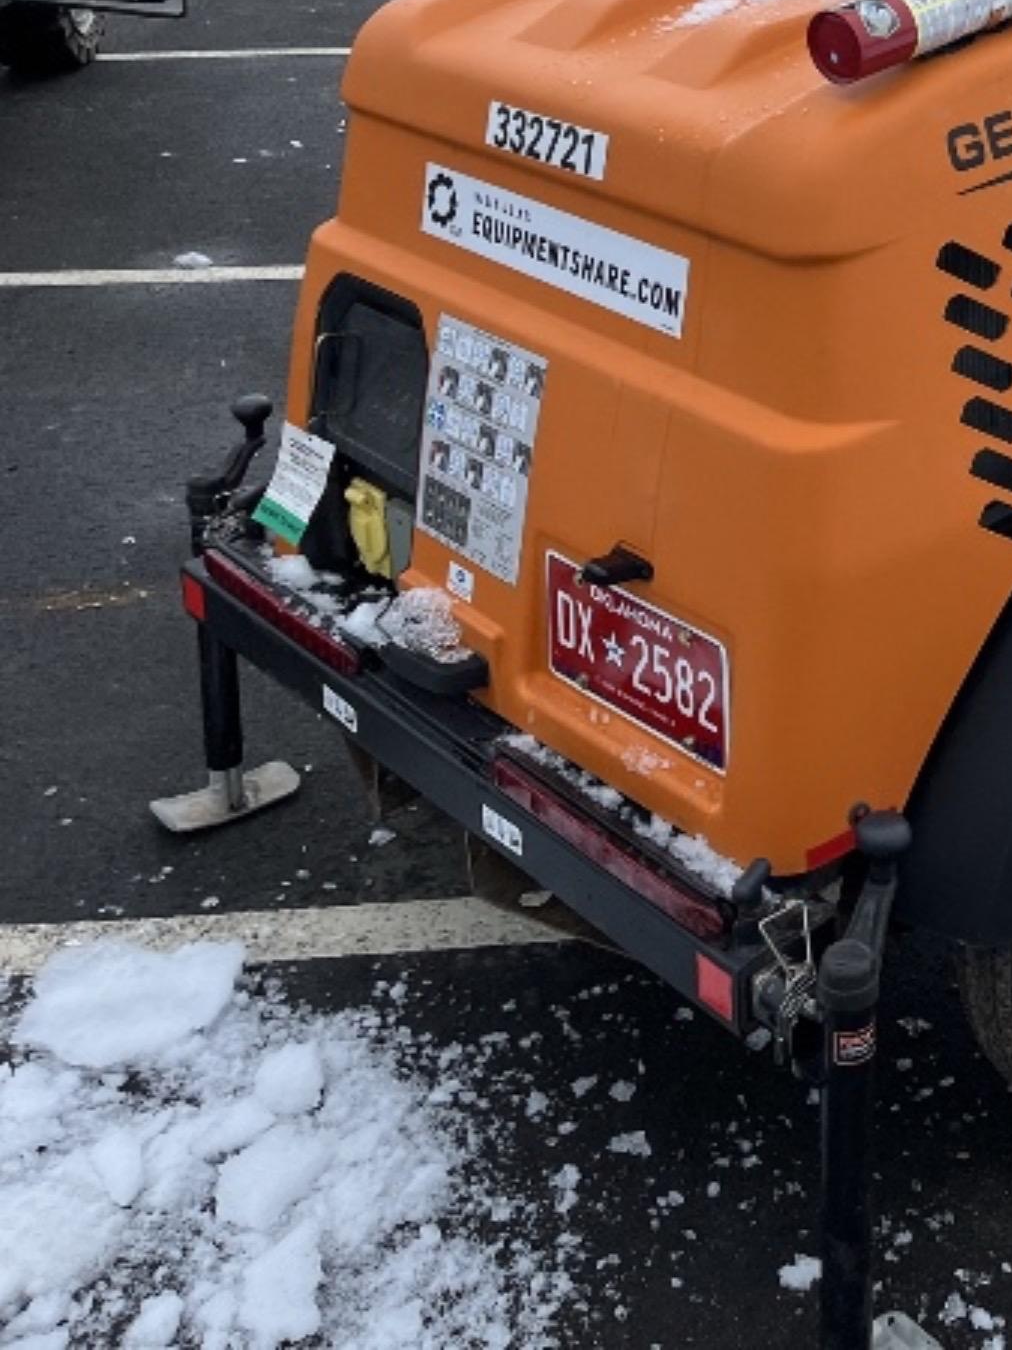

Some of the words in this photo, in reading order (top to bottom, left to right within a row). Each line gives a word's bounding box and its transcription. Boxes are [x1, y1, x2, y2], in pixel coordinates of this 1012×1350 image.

[494, 105, 595, 175] 332721
[472, 211, 682, 318] EQUIPMENTSHARE.COM
[557, 589, 595, 664] DX
[629, 634, 718, 734] 2582
